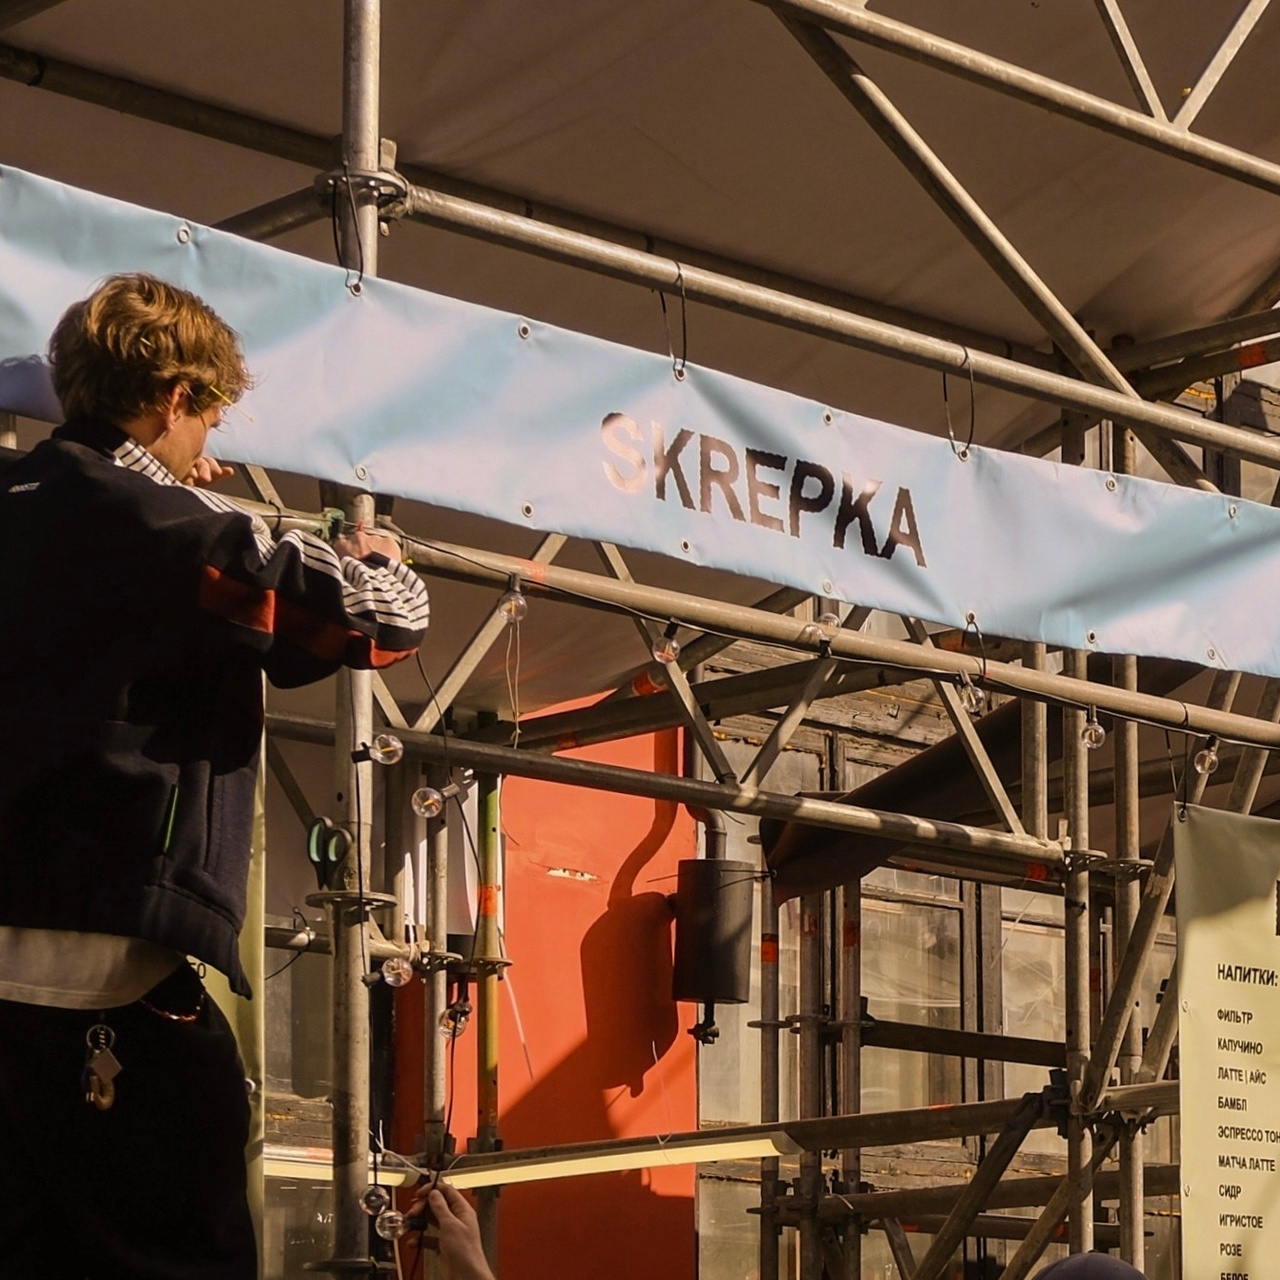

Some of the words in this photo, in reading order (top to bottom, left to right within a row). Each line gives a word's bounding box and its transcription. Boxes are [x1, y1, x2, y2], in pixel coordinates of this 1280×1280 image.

[601, 412, 926, 568] SKREPKA
[1217, 963, 1278, 986] НАПИТКИ:
[1217, 1009, 1253, 1025] ФИЛЬТР
[1217, 1037, 1263, 1054] КАПУЧИНО
[1218, 1067, 1243, 1082] ЛАТТЕ
[1249, 1069, 1267, 1085] АЙС
[1218, 1096, 1247, 1111] БАМБЛ
[1218, 1126, 1263, 1142] ЭСПРЕССО
[1219, 1155, 1247, 1169] МАТЧА
[1249, 1158, 1275, 1171] ЛАТТЕ
[1219, 1184, 1242, 1200] СИДР
[1220, 1214, 1263, 1229] ИГРИСТОЕ
[1220, 1243, 1242, 1256] РОЗЕ
